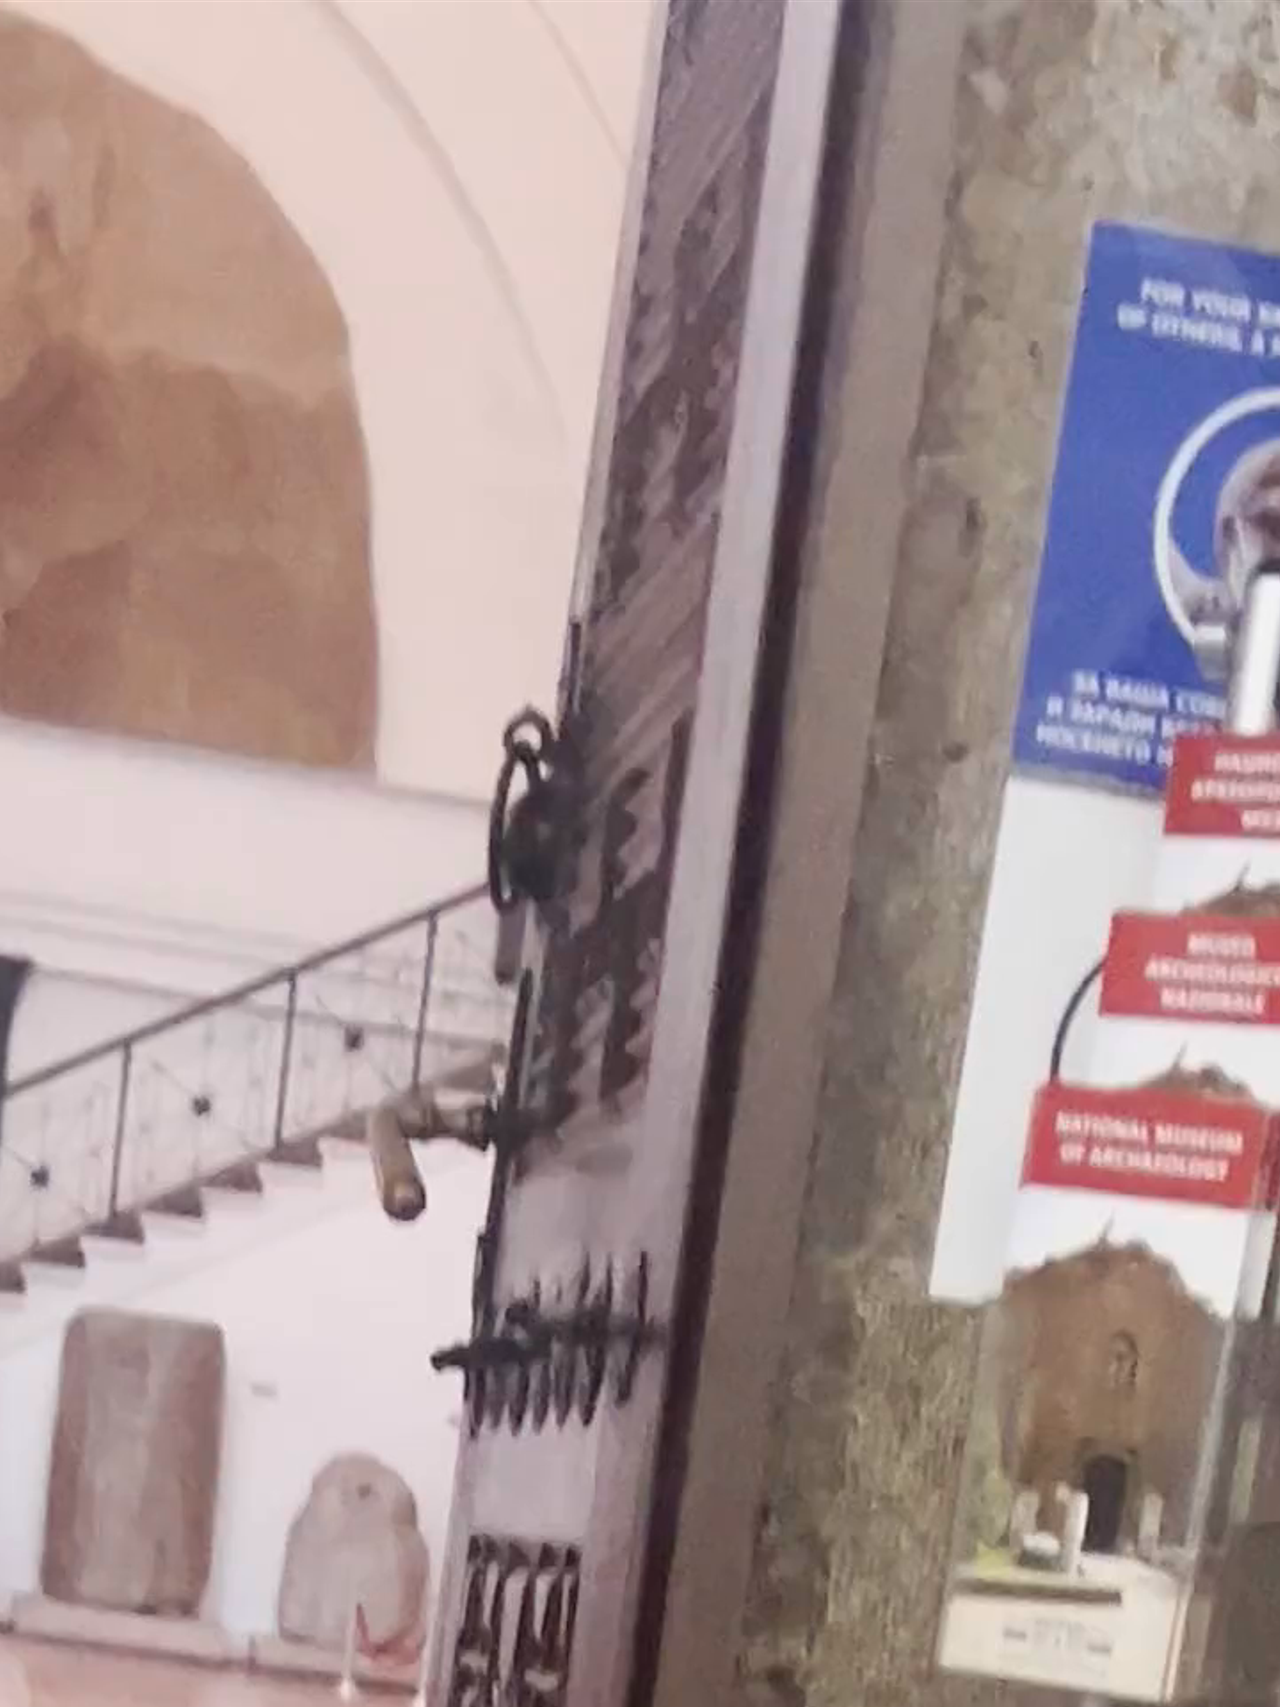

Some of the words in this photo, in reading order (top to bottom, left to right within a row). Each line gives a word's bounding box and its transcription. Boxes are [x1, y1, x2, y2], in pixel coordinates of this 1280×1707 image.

[1141, 277, 1185, 307] FOR
[1191, 290, 1250, 321] YOUR
[1117, 302, 1147, 330] OF
[1251, 327, 1265, 354] A
[1187, 933, 1255, 959] MUSEO
[1160, 987, 1265, 1015] NAZIONALE
[1055, 1110, 1148, 1142] NATIONAL
[1154, 1122, 1243, 1155] MUSEUM
[1059, 1143, 1085, 1165] OF
[1089, 1146, 1230, 1182] ARCHAEOLOGY
